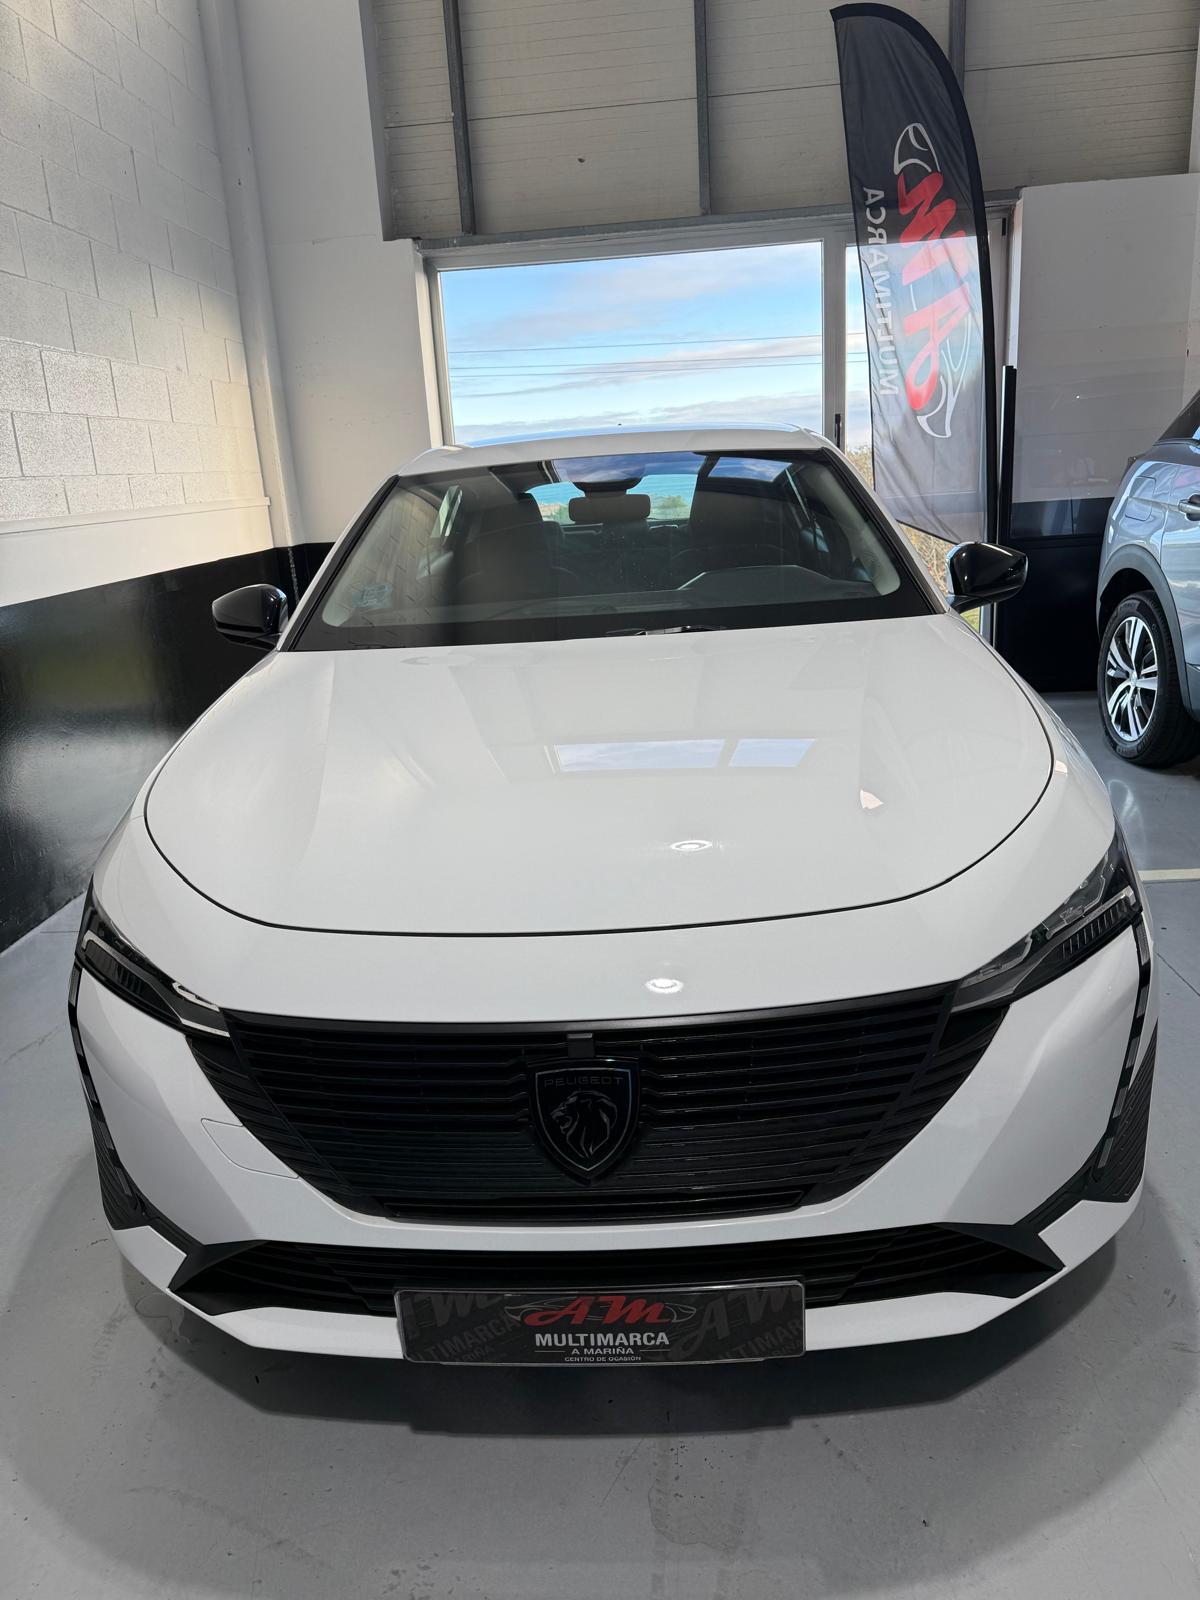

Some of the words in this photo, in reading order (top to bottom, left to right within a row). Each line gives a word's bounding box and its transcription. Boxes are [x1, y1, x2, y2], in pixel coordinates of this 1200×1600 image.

[544, 1076, 624, 1088] PEUGEOT
[534, 1331, 670, 1347] MULTIMARCA
[571, 1347, 580, 1355] A
[583, 1346, 634, 1355] MARIÑA
